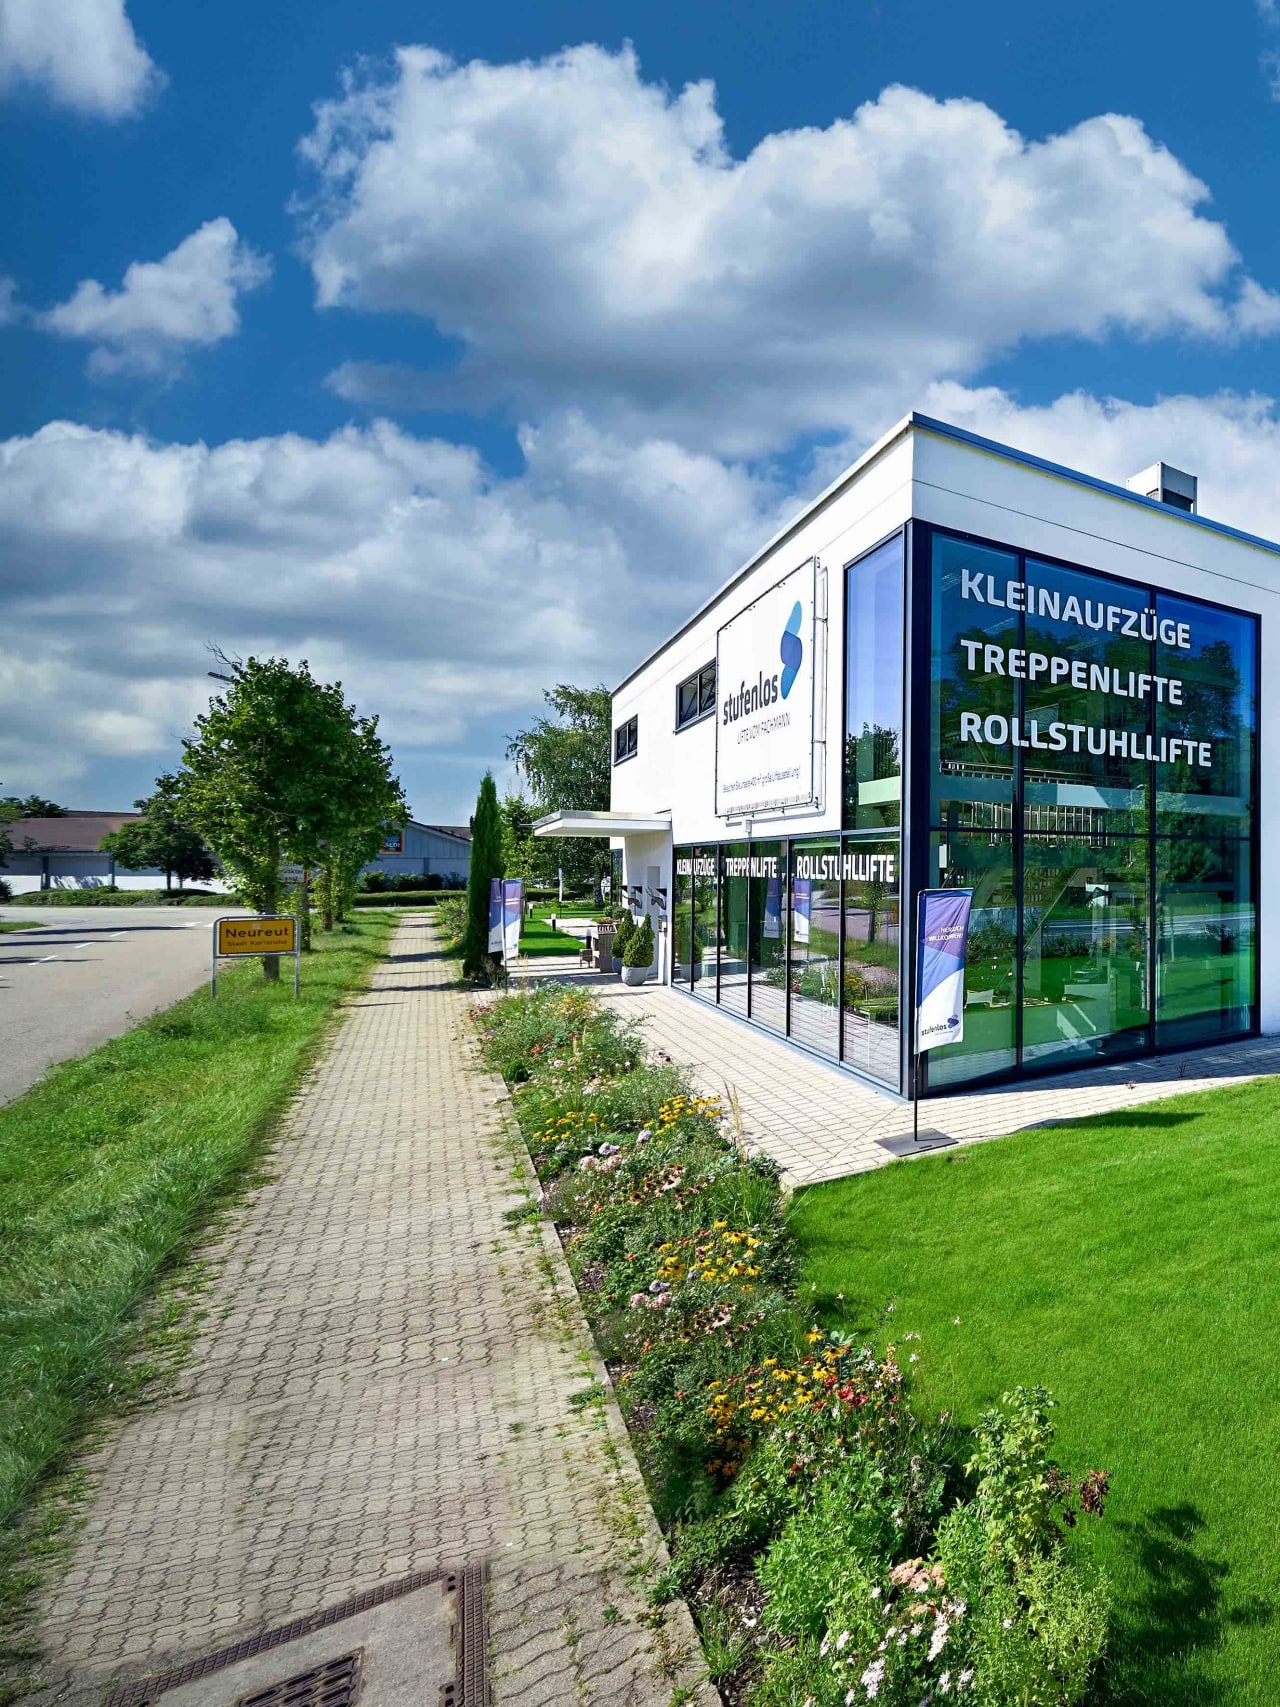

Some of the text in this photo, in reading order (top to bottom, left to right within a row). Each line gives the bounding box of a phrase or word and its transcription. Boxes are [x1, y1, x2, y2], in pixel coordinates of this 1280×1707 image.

[960, 567, 1191, 649] KLEINAUFZÜGE
[723, 671, 778, 726] stufenlos
[960, 639, 1183, 706] TREPPENLIFTE
[960, 711, 1212, 767] ROLLSTUHLLIFTE
[725, 856, 778, 878] TREPPENLIFTE
[796, 854, 895, 882] ROLLSTUHLLIFTE
[225, 927, 289, 938] Neureut
